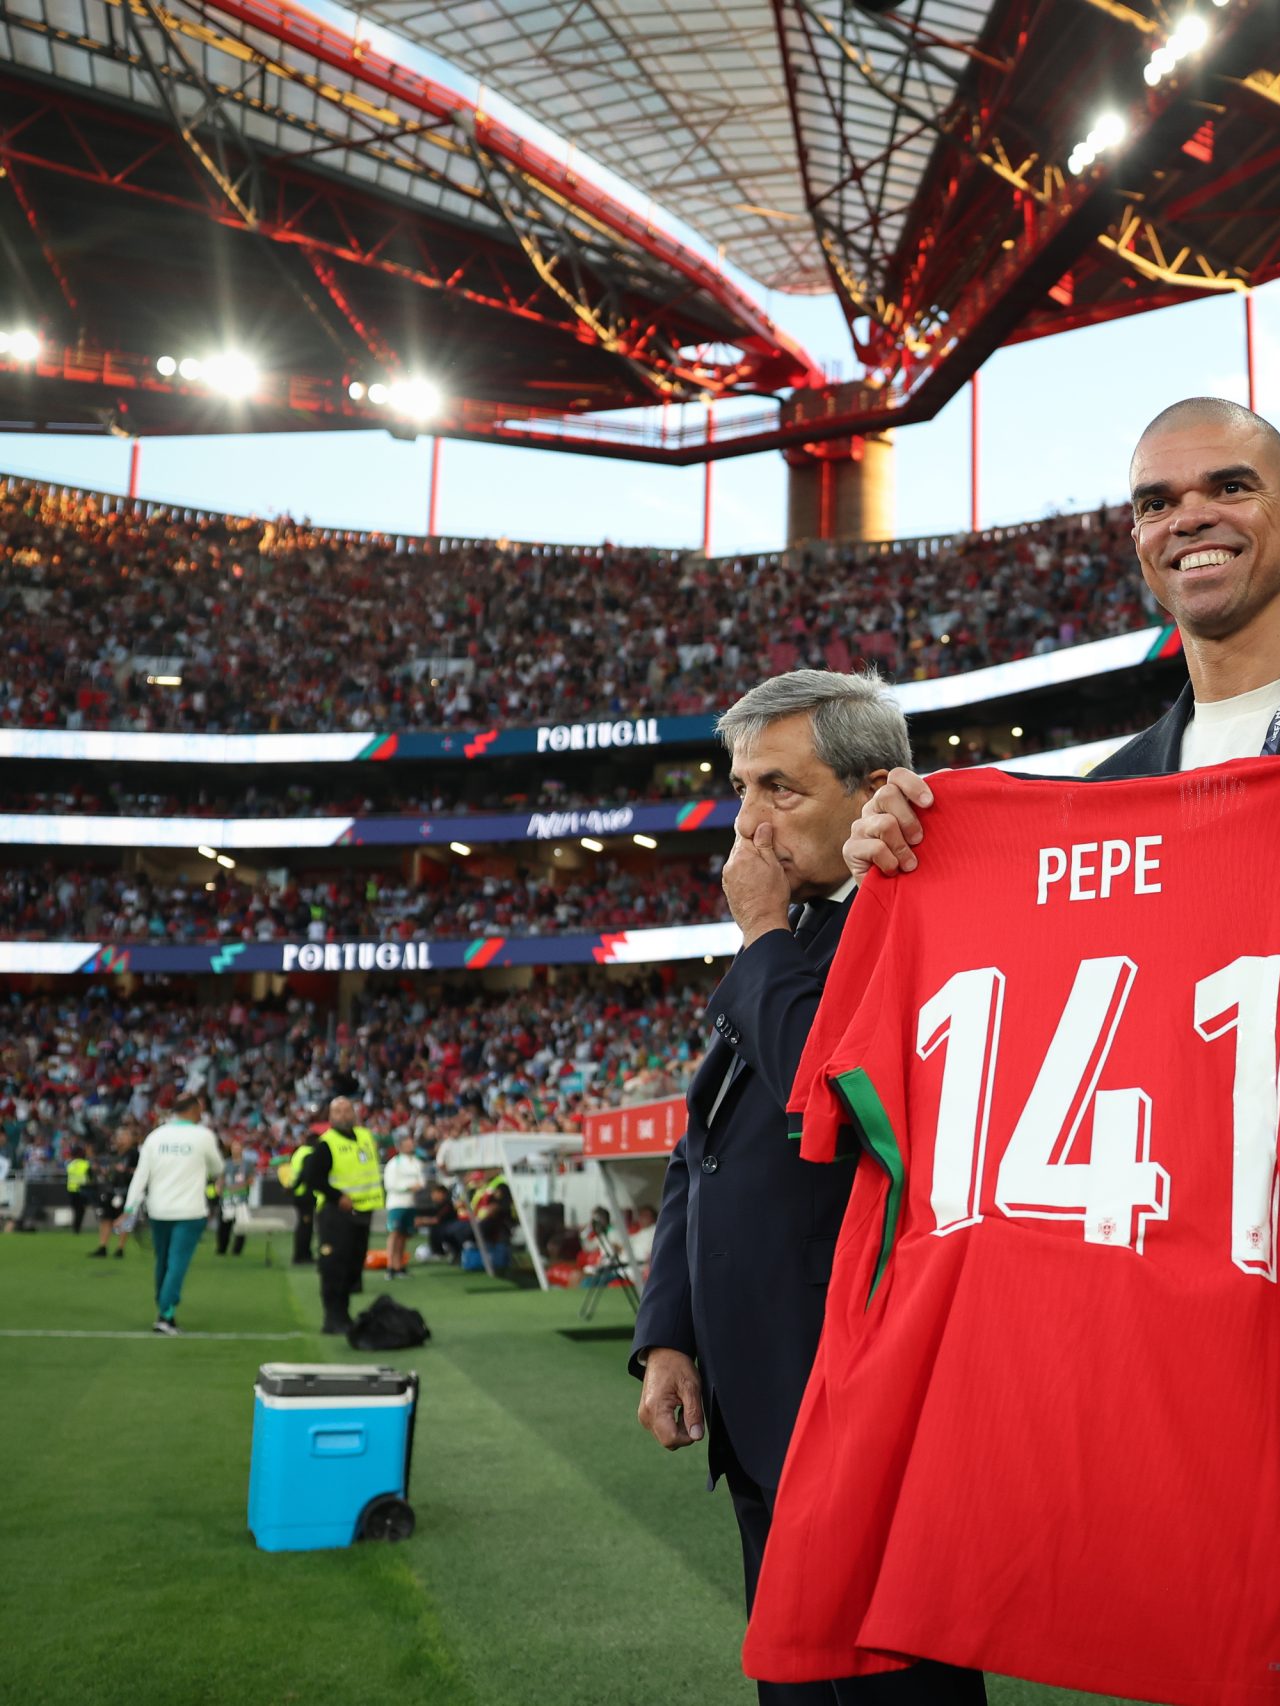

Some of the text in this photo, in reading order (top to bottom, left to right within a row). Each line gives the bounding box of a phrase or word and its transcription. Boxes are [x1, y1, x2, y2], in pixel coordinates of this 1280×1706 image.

[537, 718, 661, 752] PORTUGAL
[1037, 835, 1162, 905] PEPE
[283, 942, 432, 971] PORTUGAL
